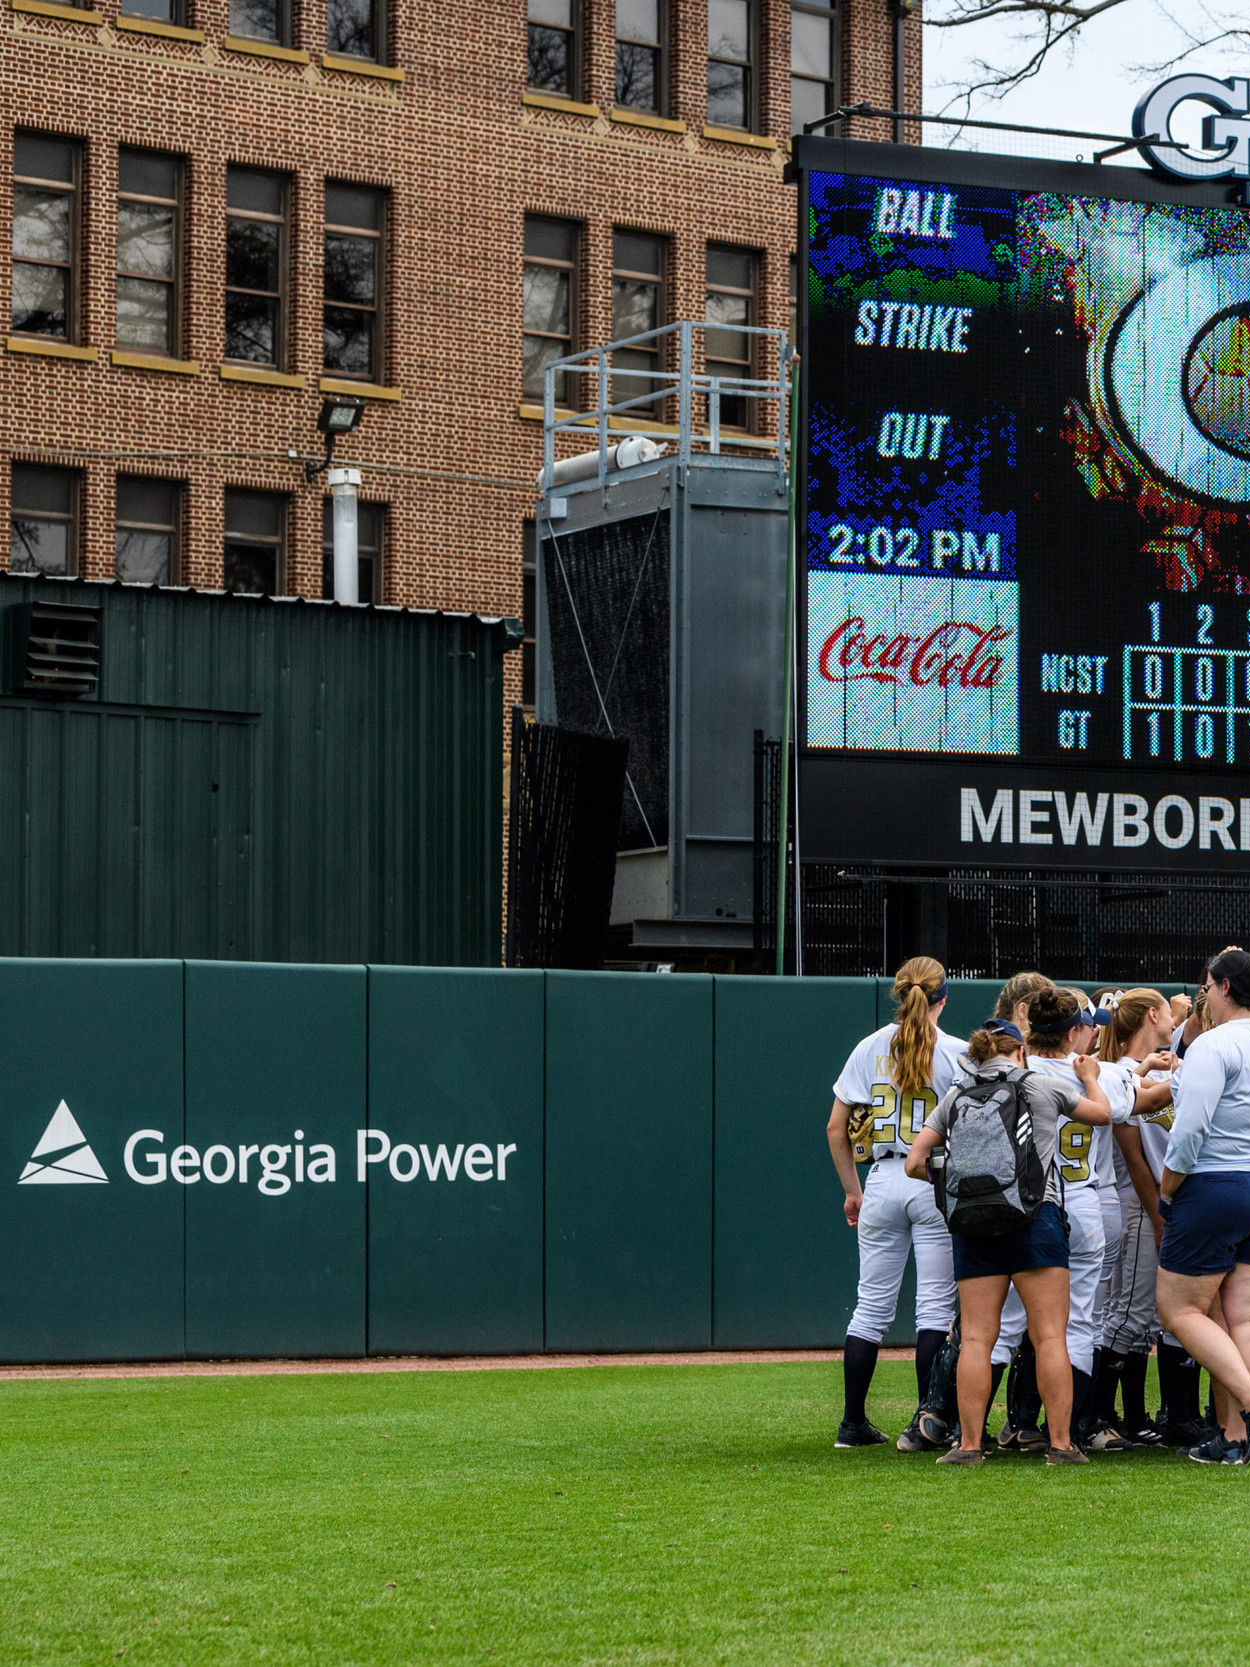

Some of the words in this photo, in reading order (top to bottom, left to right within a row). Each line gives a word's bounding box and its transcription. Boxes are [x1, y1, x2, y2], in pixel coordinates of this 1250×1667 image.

[877, 187, 957, 238] BALL
[854, 300, 973, 353] STRIKE
[877, 413, 950, 460] OUT
[828, 523, 920, 568] 2:02
[932, 529, 1001, 572] PM
[1148, 602, 1161, 642] 1
[1196, 604, 1214, 644] 2
[1040, 653, 1108, 694] NCST
[1144, 654, 1163, 699] 0
[1195, 657, 1214, 701] 0
[1058, 709, 1091, 749] GT
[1146, 712, 1160, 757] 1
[1195, 714, 1214, 758] 0
[871, 1083, 938, 1145] 20
[123, 1129, 337, 1196] Georgia
[357, 1128, 517, 1182] Power
[1059, 1120, 1094, 1182] 9
